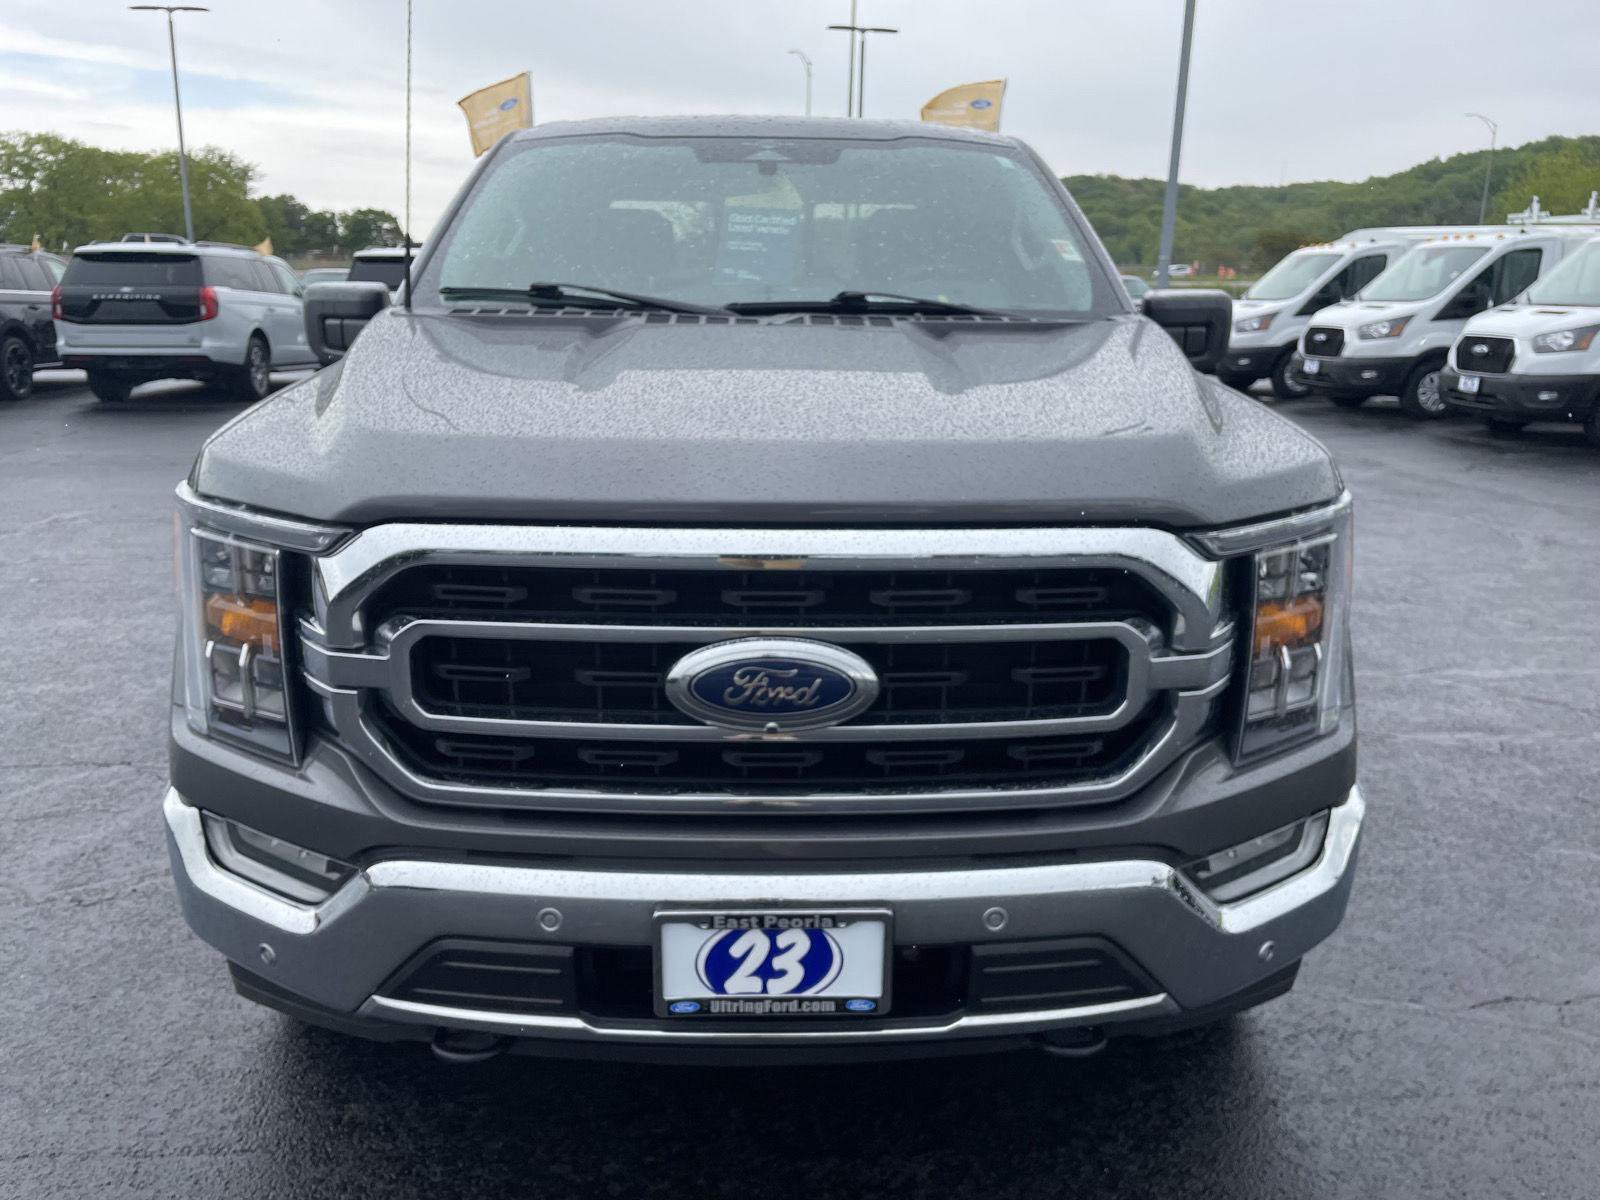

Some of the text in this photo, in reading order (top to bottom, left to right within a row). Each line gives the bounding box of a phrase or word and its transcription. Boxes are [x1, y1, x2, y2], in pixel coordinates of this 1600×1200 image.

[723, 666, 822, 706] Ford
[712, 914, 833, 929] East Peoria
[724, 929, 811, 995] 23
